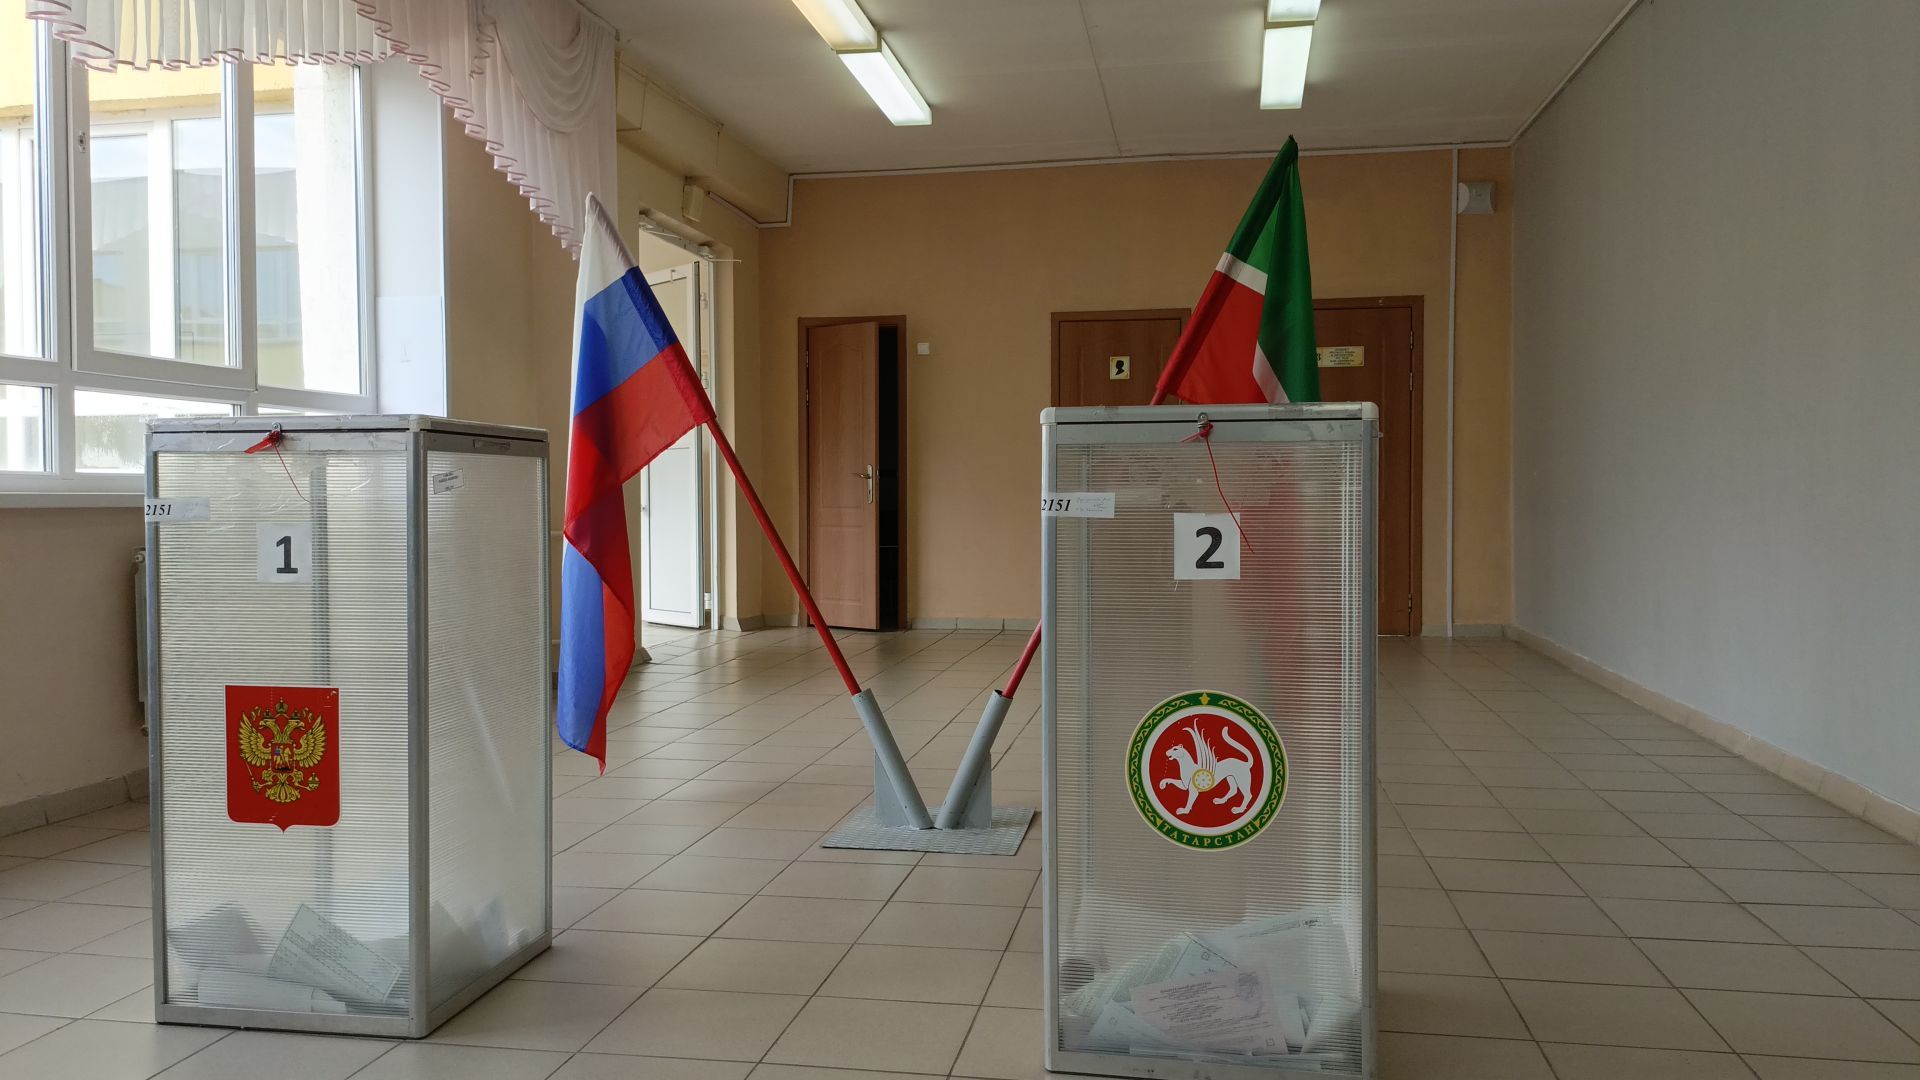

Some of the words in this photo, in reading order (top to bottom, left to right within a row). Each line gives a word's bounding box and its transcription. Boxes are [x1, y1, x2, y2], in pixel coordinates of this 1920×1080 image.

[145, 504, 172, 516] 2151
[1041, 498, 1071, 512] 2151
[276, 535, 298, 574] 1
[1195, 526, 1225, 569] 2
[1162, 824, 1254, 846] ТАТАРСТАН
